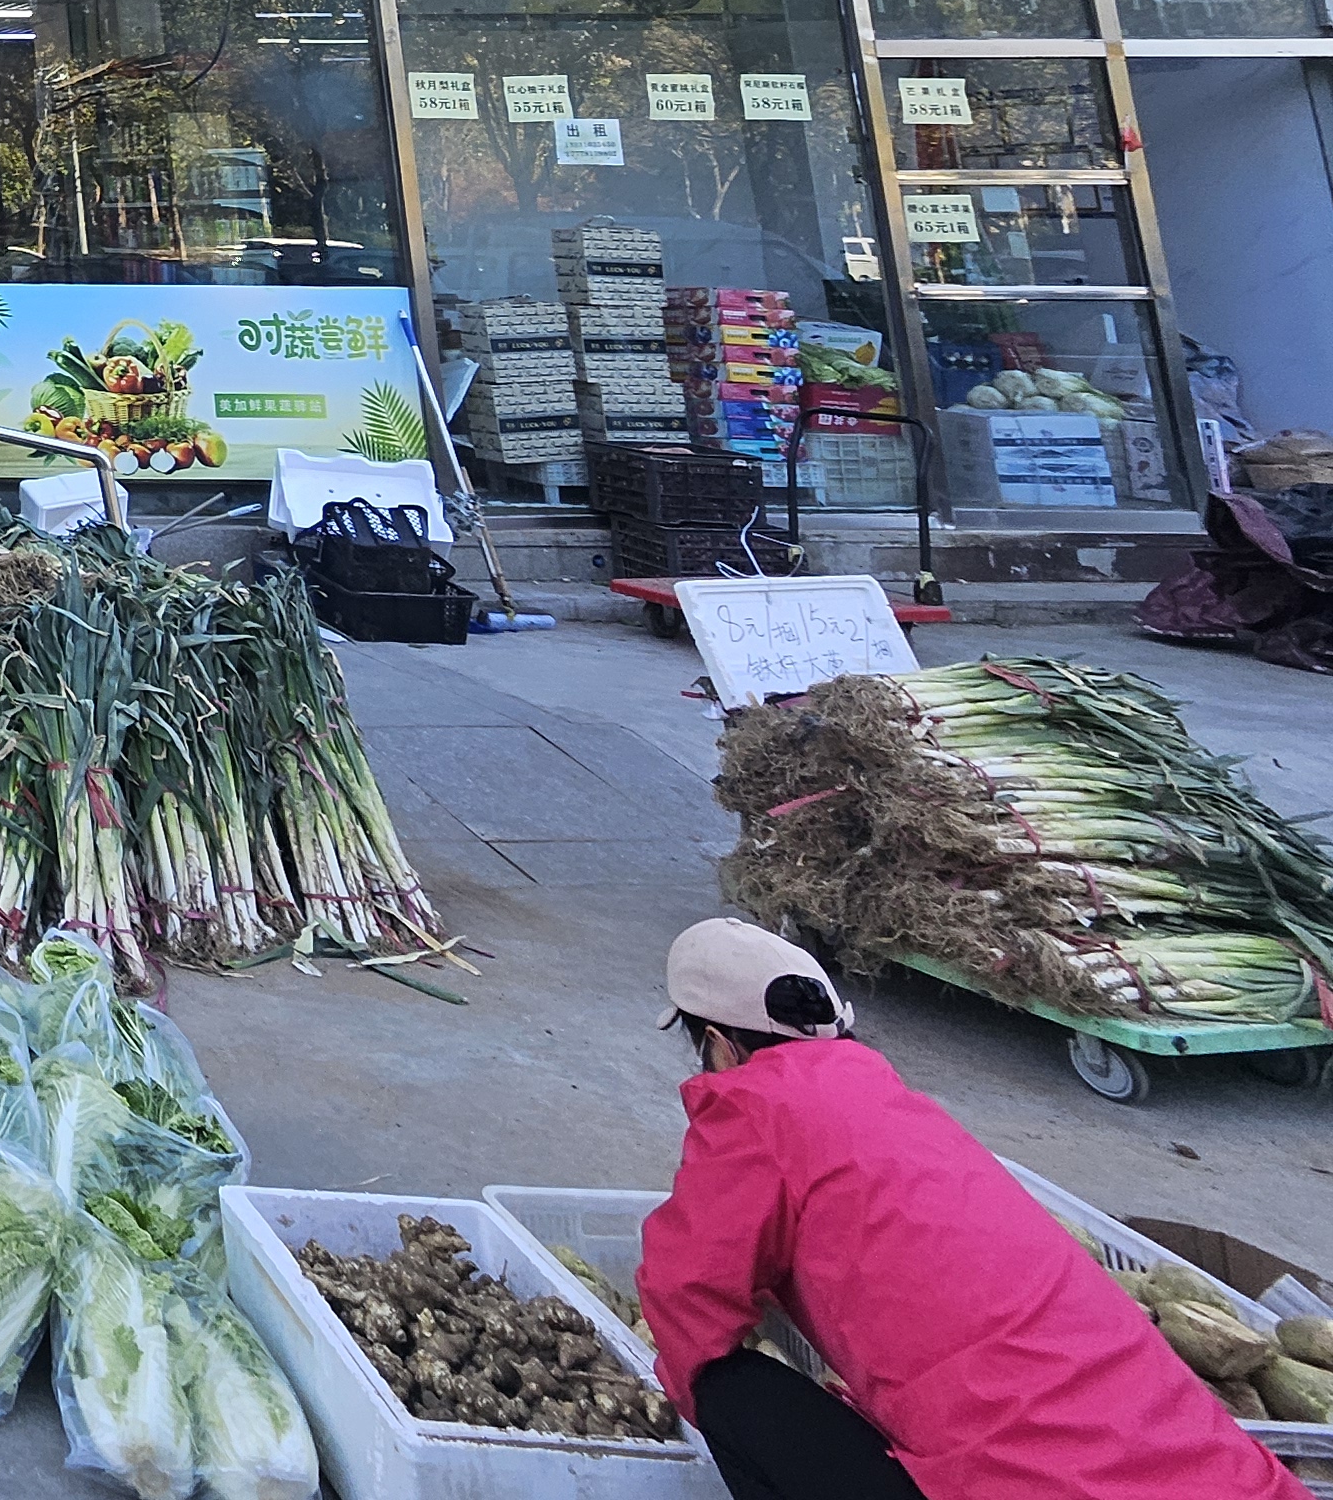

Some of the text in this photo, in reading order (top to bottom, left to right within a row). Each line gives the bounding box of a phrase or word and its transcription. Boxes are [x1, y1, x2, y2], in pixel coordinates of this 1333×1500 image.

[415, 79, 471, 92] 秋月梨礼盒
[906, 87, 961, 97] 芒果礼盒
[419, 97, 471, 111] 58元1箱
[513, 101, 565, 114] 55元1箱
[656, 99, 707, 113] 60元1箱
[751, 97, 804, 112] 58元1箱
[909, 104, 962, 117] 58元1箱
[566, 123, 608, 138] 出租
[914, 220, 970, 234] 65元1箱
[237, 311, 389, 361] 时蔬尝鲜
[219, 398, 322, 413] 美加鲜果蔬驿站
